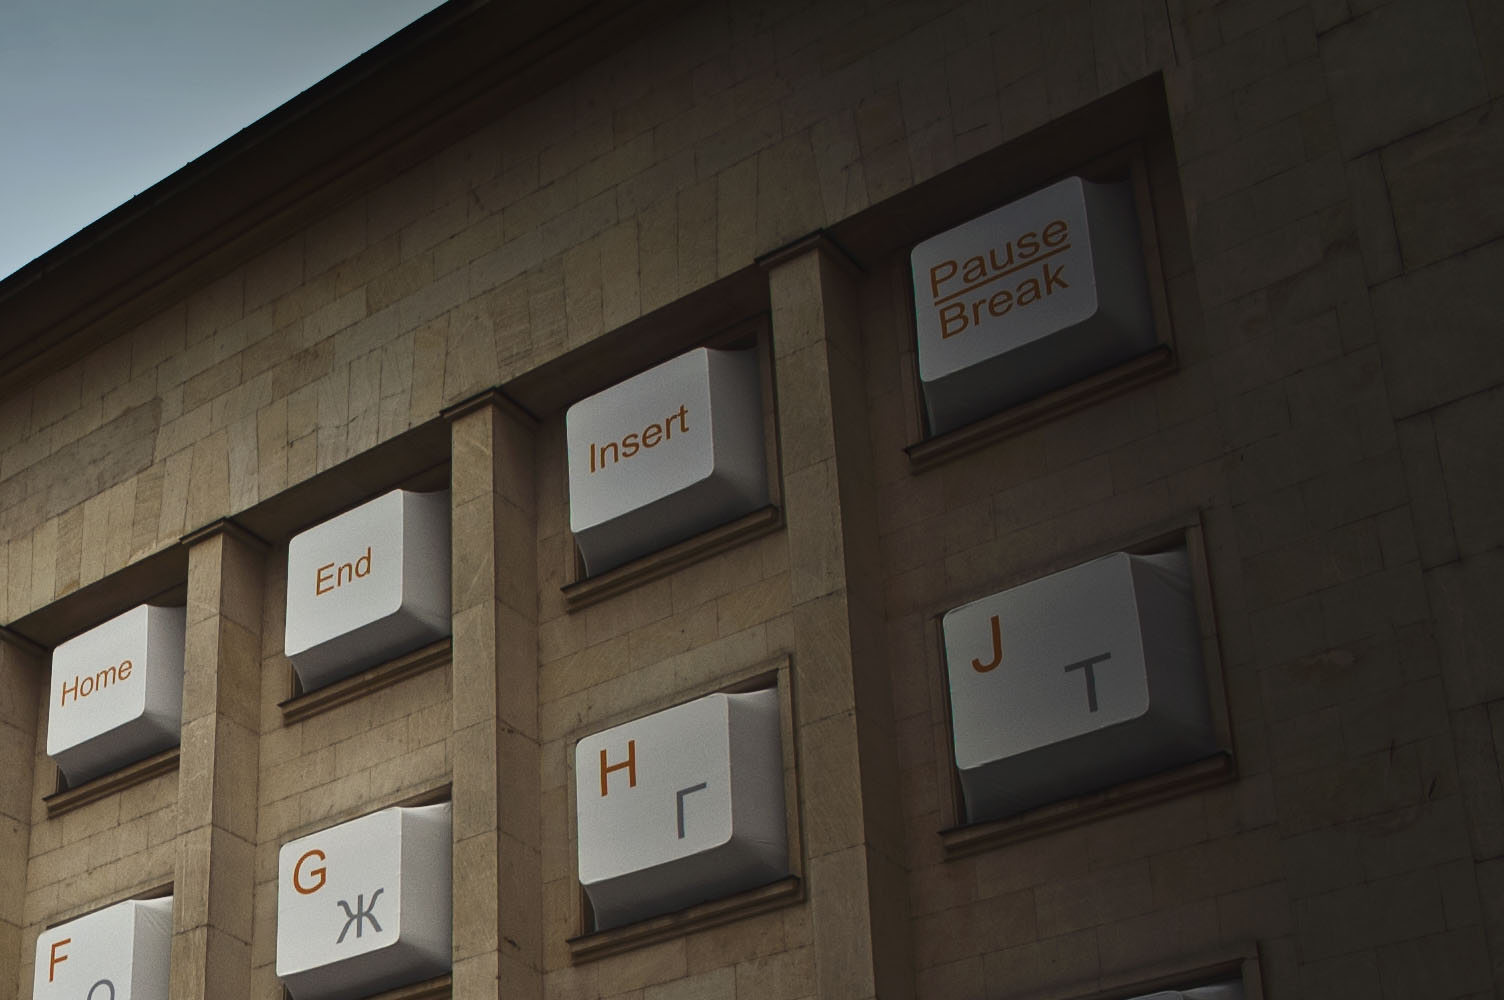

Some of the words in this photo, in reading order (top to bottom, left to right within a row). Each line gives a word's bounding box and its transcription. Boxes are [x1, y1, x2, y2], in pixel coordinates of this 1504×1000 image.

[929, 218, 1070, 298] Pause
[938, 262, 1071, 339] Break
[589, 404, 690, 473] Insert
[315, 546, 372, 597] End
[971, 614, 1003, 674] J
[60, 658, 134, 708] Home
[1064, 652, 1112, 714] Т
[599, 739, 637, 797] H
[676, 781, 708, 840] Г
[293, 848, 328, 895] G
[335, 887, 385, 945] Ж
[48, 937, 73, 983] F
